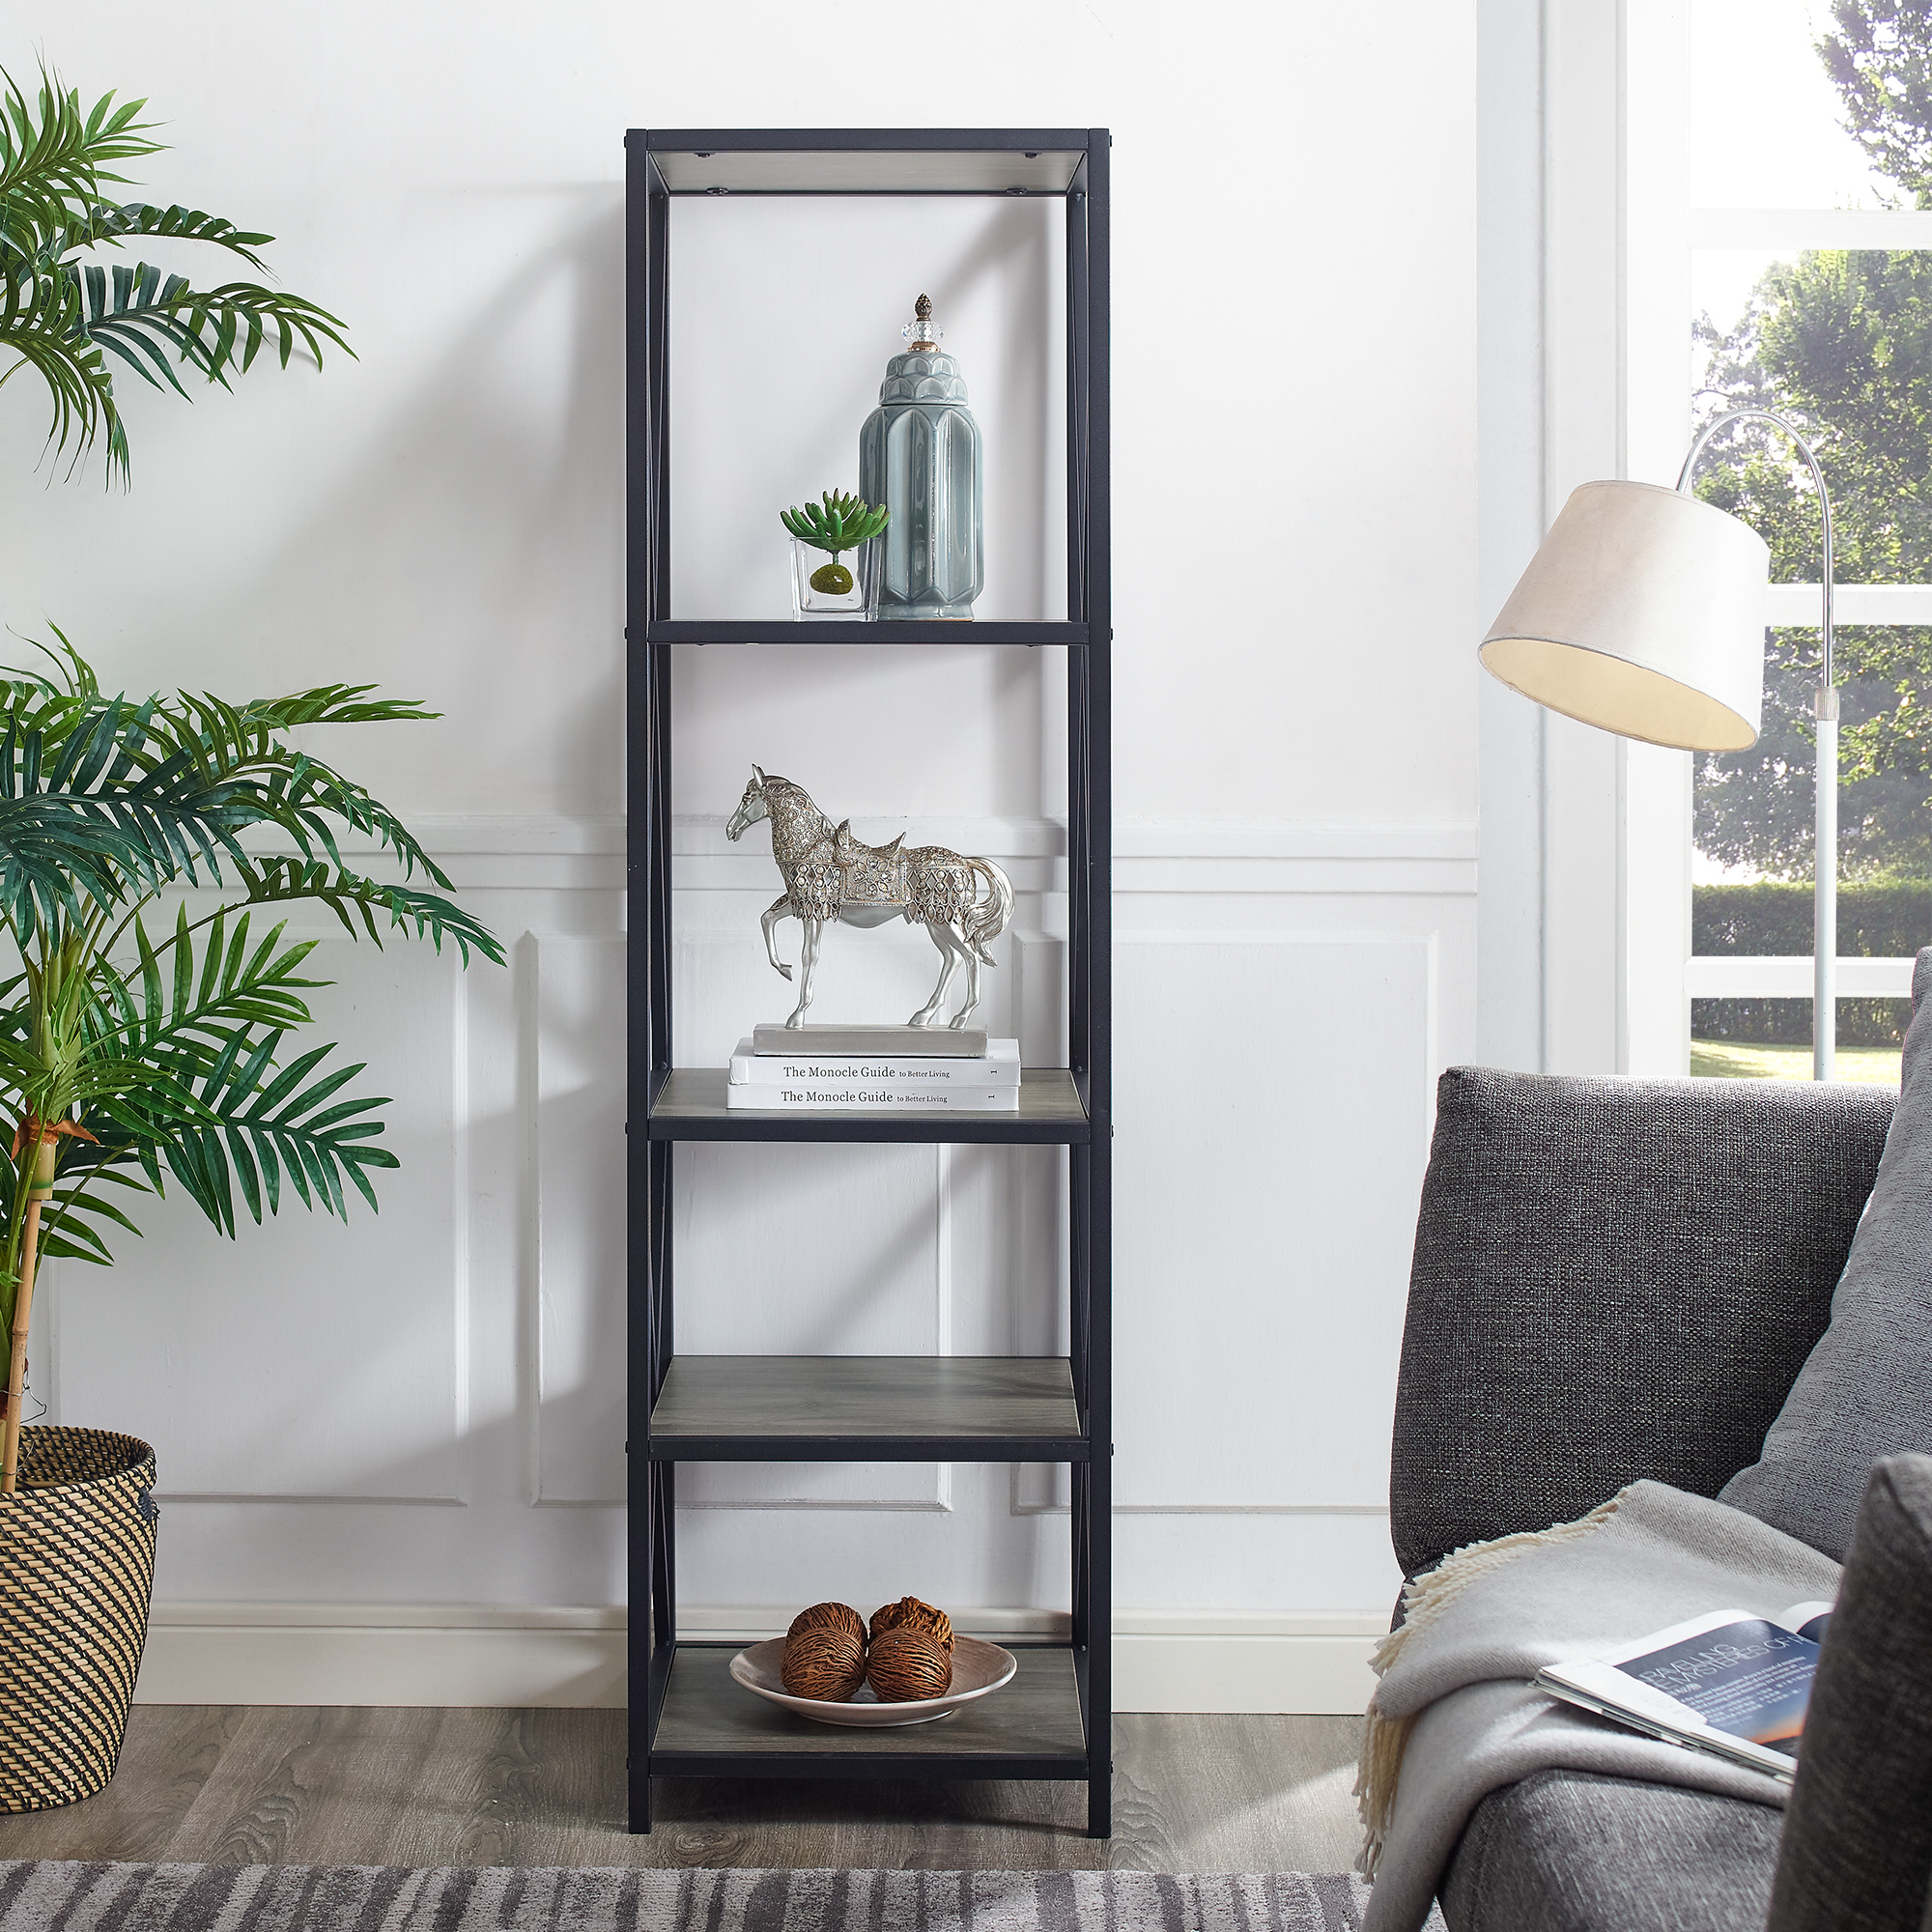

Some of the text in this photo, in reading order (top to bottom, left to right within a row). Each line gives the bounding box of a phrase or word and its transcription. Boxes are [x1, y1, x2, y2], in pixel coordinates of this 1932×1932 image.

[783, 1066, 806, 1077] The
[809, 1066, 858, 1077] Monocle
[861, 1066, 895, 1078] Guide
[929, 1070, 950, 1079] Living
[781, 1091, 803, 1101] The
[806, 1091, 855, 1102] Monocle
[859, 1091, 893, 1102] Guide
[926, 1094, 948, 1103] Living
